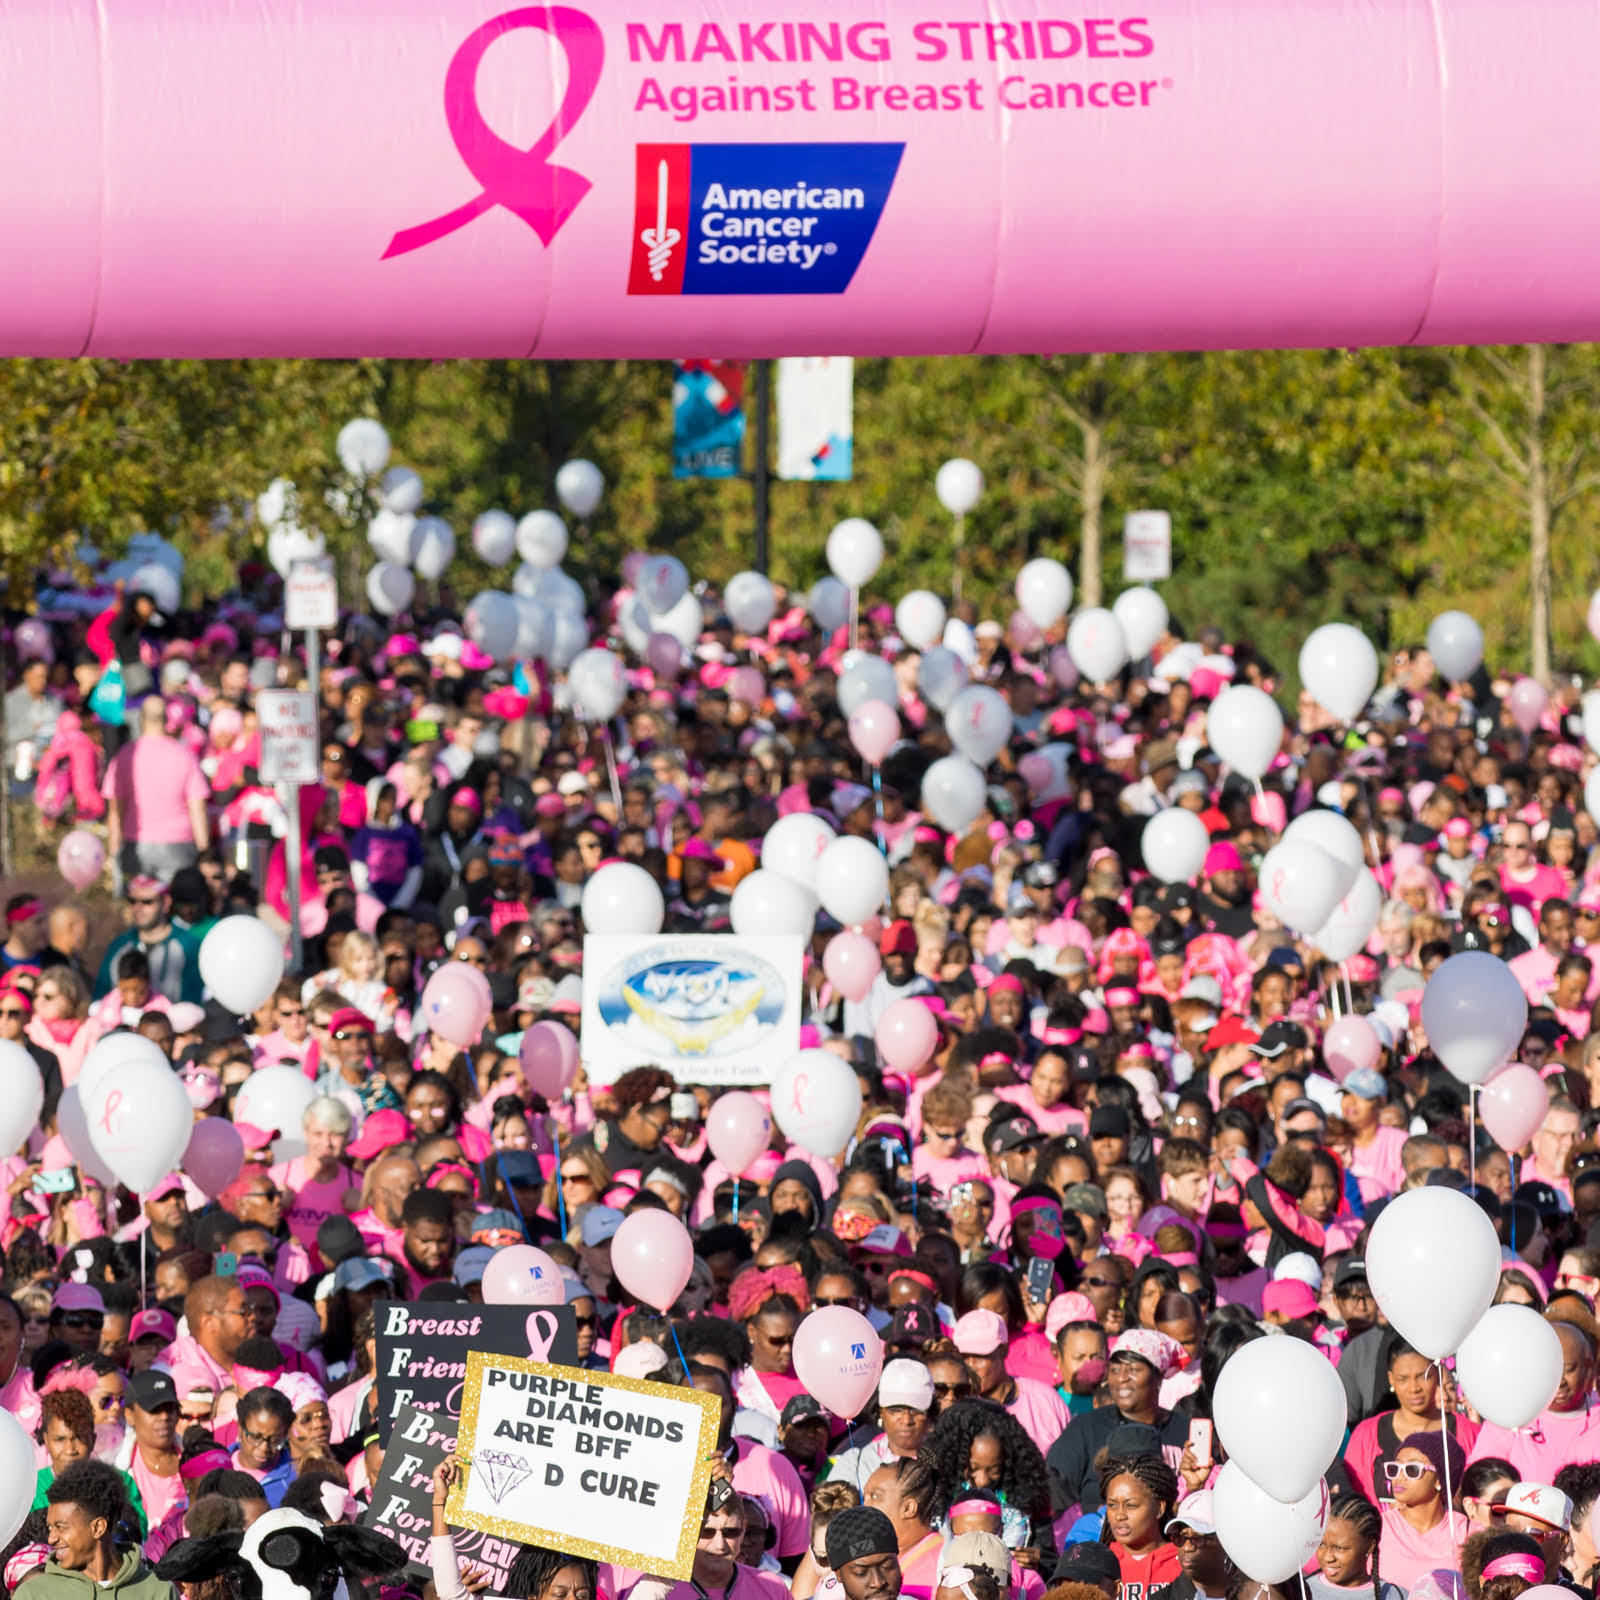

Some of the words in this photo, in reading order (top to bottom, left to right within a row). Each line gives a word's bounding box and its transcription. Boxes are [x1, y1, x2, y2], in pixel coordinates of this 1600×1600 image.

[626, 22, 891, 63] MAKING
[913, 18, 1154, 62] STRIDES
[634, 76, 817, 121] Against
[832, 76, 984, 112] Breast
[702, 182, 865, 209] American
[701, 213, 818, 238] Cancer
[383, 1306, 483, 1337] Breast
[388, 1347, 466, 1379] Frien
[839, 1361, 878, 1375] ALLIANCE
[389, 1389, 441, 1419] For
[487, 1369, 604, 1406] PURPLE
[401, 1410, 458, 1455] Bre
[526, 1397, 684, 1442] DIAMONDS
[493, 1419, 554, 1448] ARE
[575, 1432, 632, 1460] BFF
[544, 1463, 564, 1486] D
[580, 1469, 660, 1506] CURE
[377, 1495, 431, 1533] For
[399, 1534, 433, 1567] YEA
